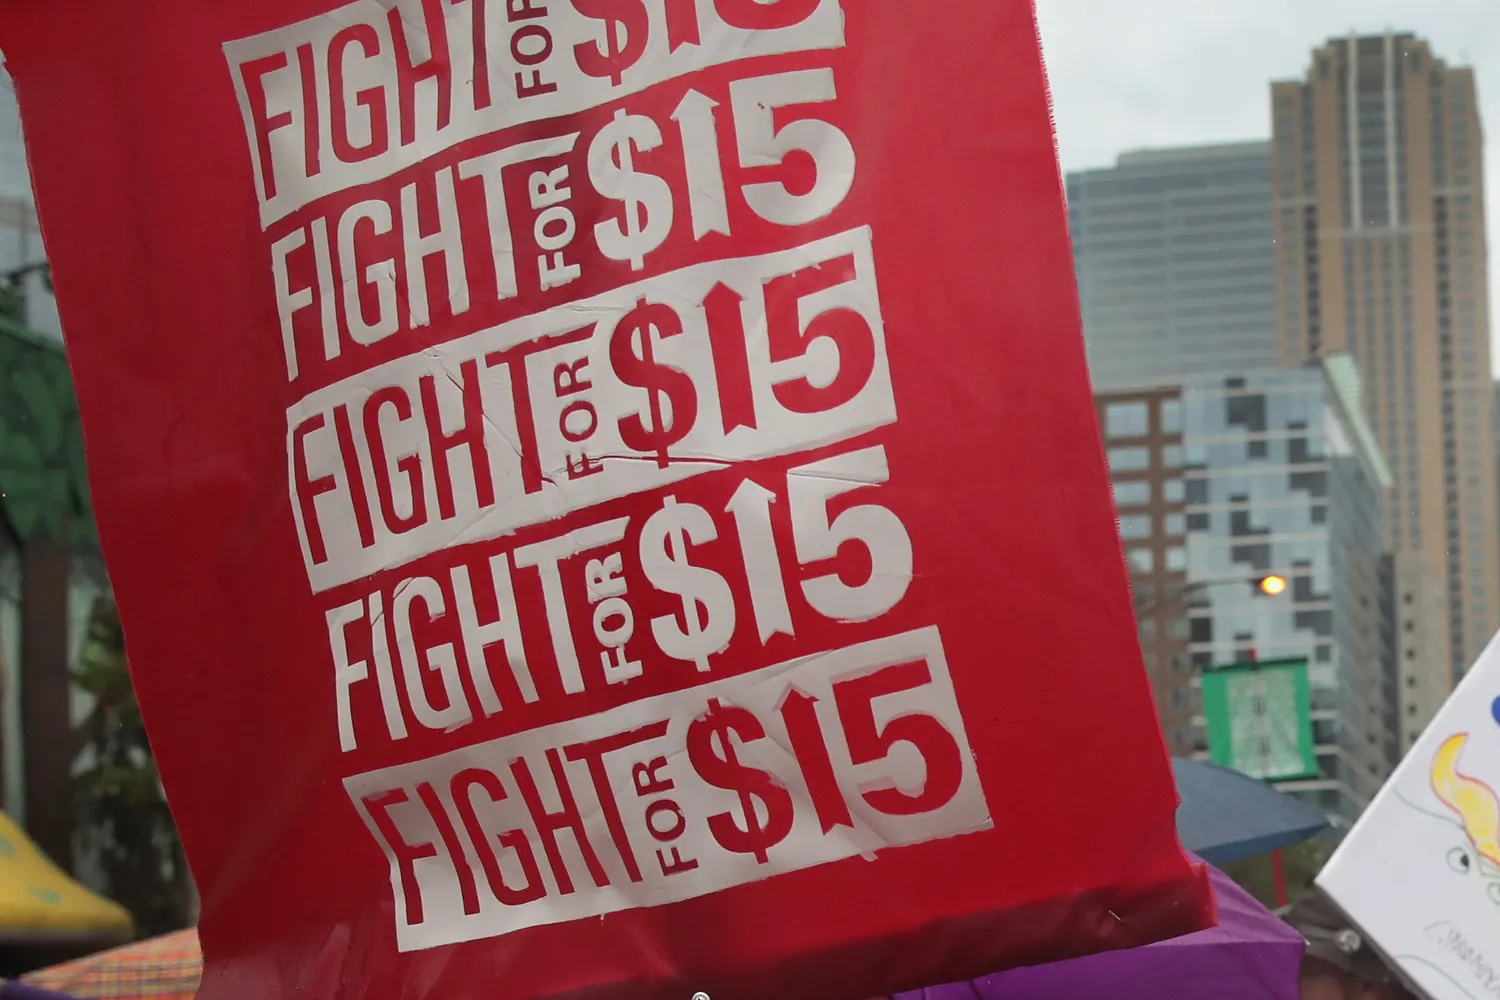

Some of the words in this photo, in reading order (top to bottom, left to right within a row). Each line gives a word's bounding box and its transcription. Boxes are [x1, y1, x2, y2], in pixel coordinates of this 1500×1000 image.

[239, 0, 491, 201] FIGHT
[270, 131, 580, 382] FIGHT
[527, 163, 582, 292] FOR
[586, 67, 857, 271] $15
[292, 321, 598, 567] FIGHT
[553, 360, 604, 481] FOR
[608, 249, 876, 469] $15
[325, 516, 630, 753] FIGHT
[584, 551, 644, 685] FOR
[639, 445, 913, 673] $15
[360, 717, 675, 926] FIGHT
[631, 755, 700, 877] FOR
[686, 654, 963, 865] $15
